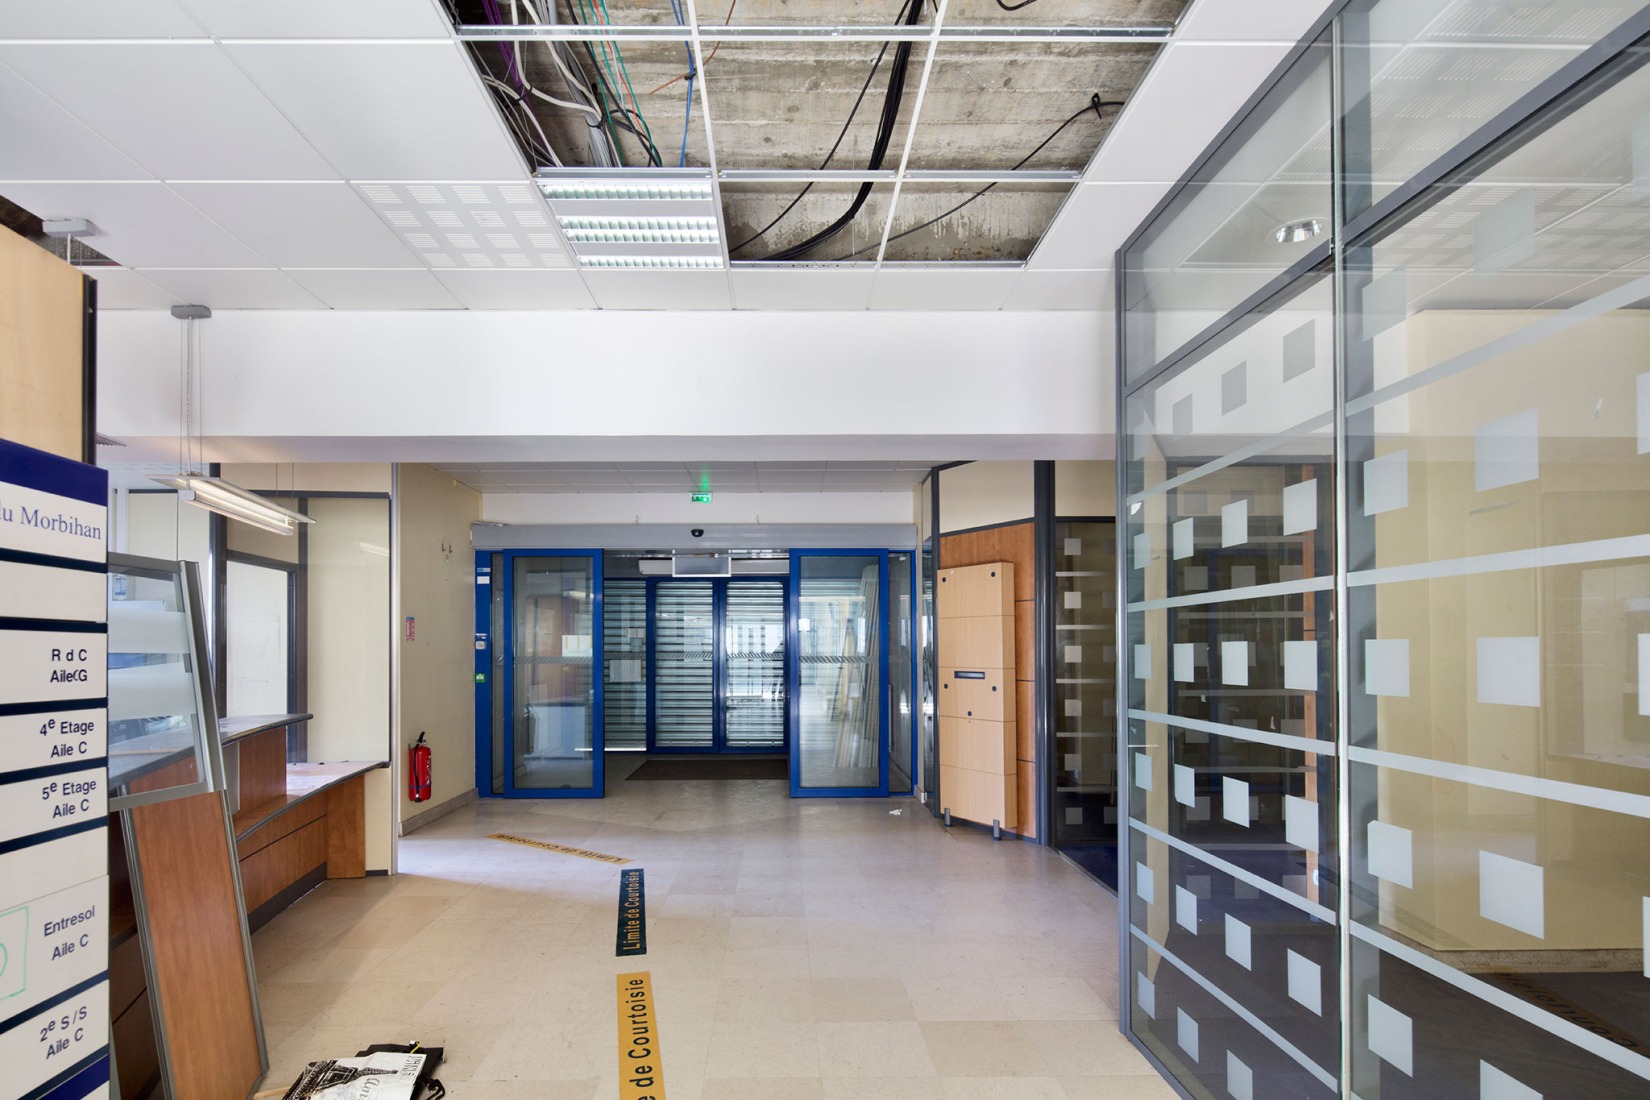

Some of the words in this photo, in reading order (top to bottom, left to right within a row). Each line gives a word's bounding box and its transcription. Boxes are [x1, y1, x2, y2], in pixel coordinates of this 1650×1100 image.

[0, 501, 13, 522] u
[20, 505, 101, 540] Morbihan
[60, 720, 95, 736] Etage
[50, 744, 74, 758] Aile
[78, 741, 88, 754] C
[62, 780, 97, 796] Etage
[52, 803, 76, 819] Aile
[80, 799, 90, 812] C
[579, 850, 622, 862] Limite
[624, 871, 640, 907] Courtoisie
[44, 905, 95, 937] Entresol
[624, 908, 640, 919] de
[51, 941, 75, 961] Aile
[79, 933, 89, 947] C
[623, 920, 641, 950] Limite
[625, 979, 651, 1059] Courtoisie
[46, 1038, 70, 1060] Aile
[74, 1027, 84, 1042] C
[629, 1065, 654, 1087] de
